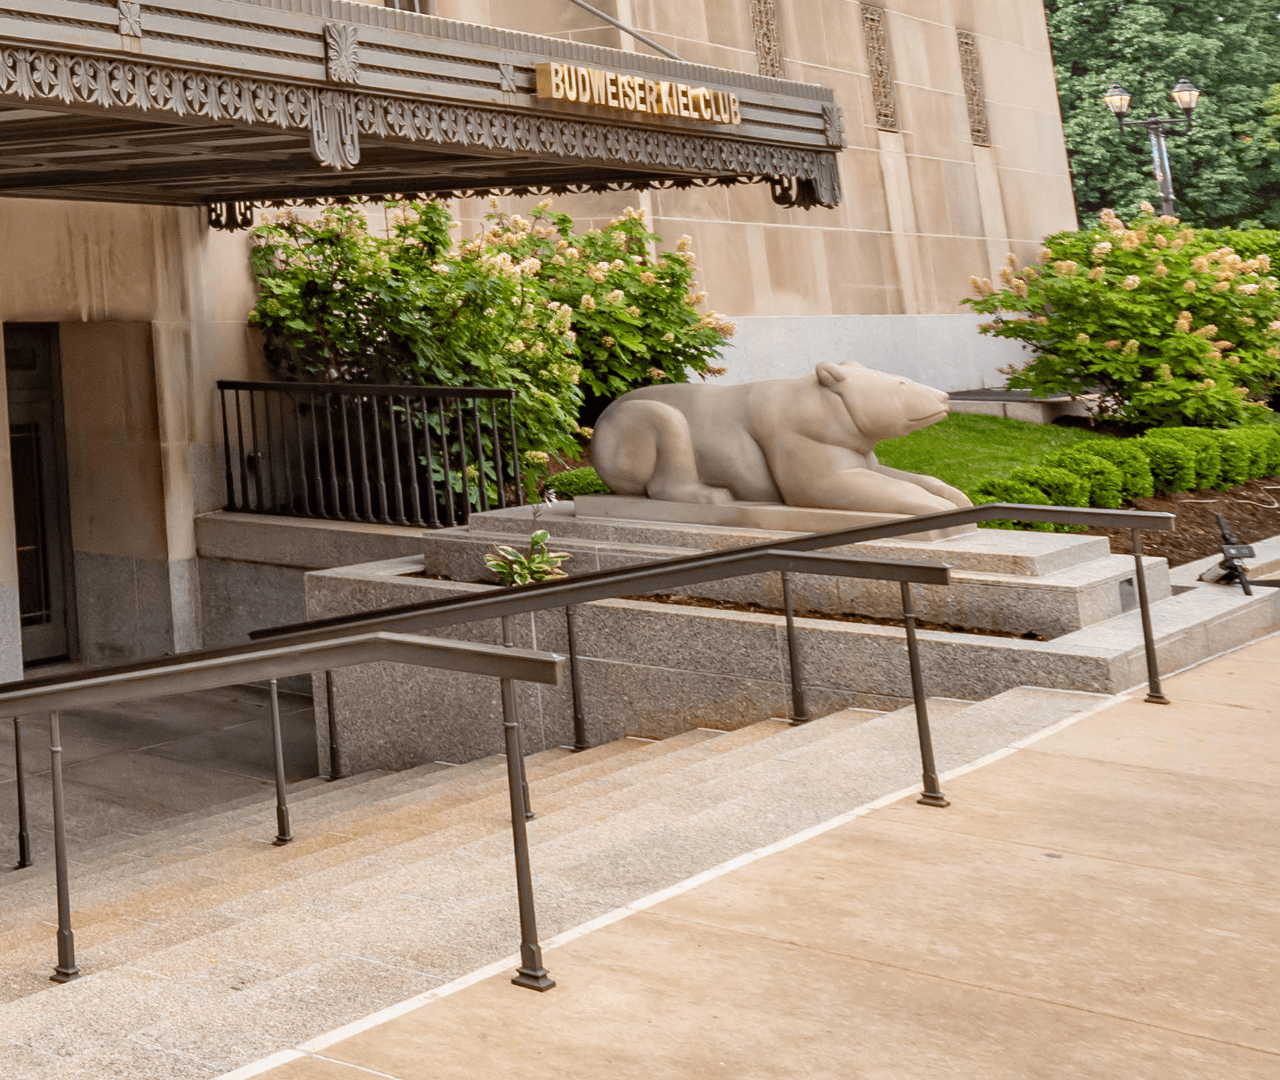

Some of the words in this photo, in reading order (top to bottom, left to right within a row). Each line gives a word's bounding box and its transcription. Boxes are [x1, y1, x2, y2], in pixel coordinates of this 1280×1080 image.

[538, 61, 659, 114] BUDWEISER
[659, 80, 699, 119] KIEL
[697, 85, 741, 125] CLUB
